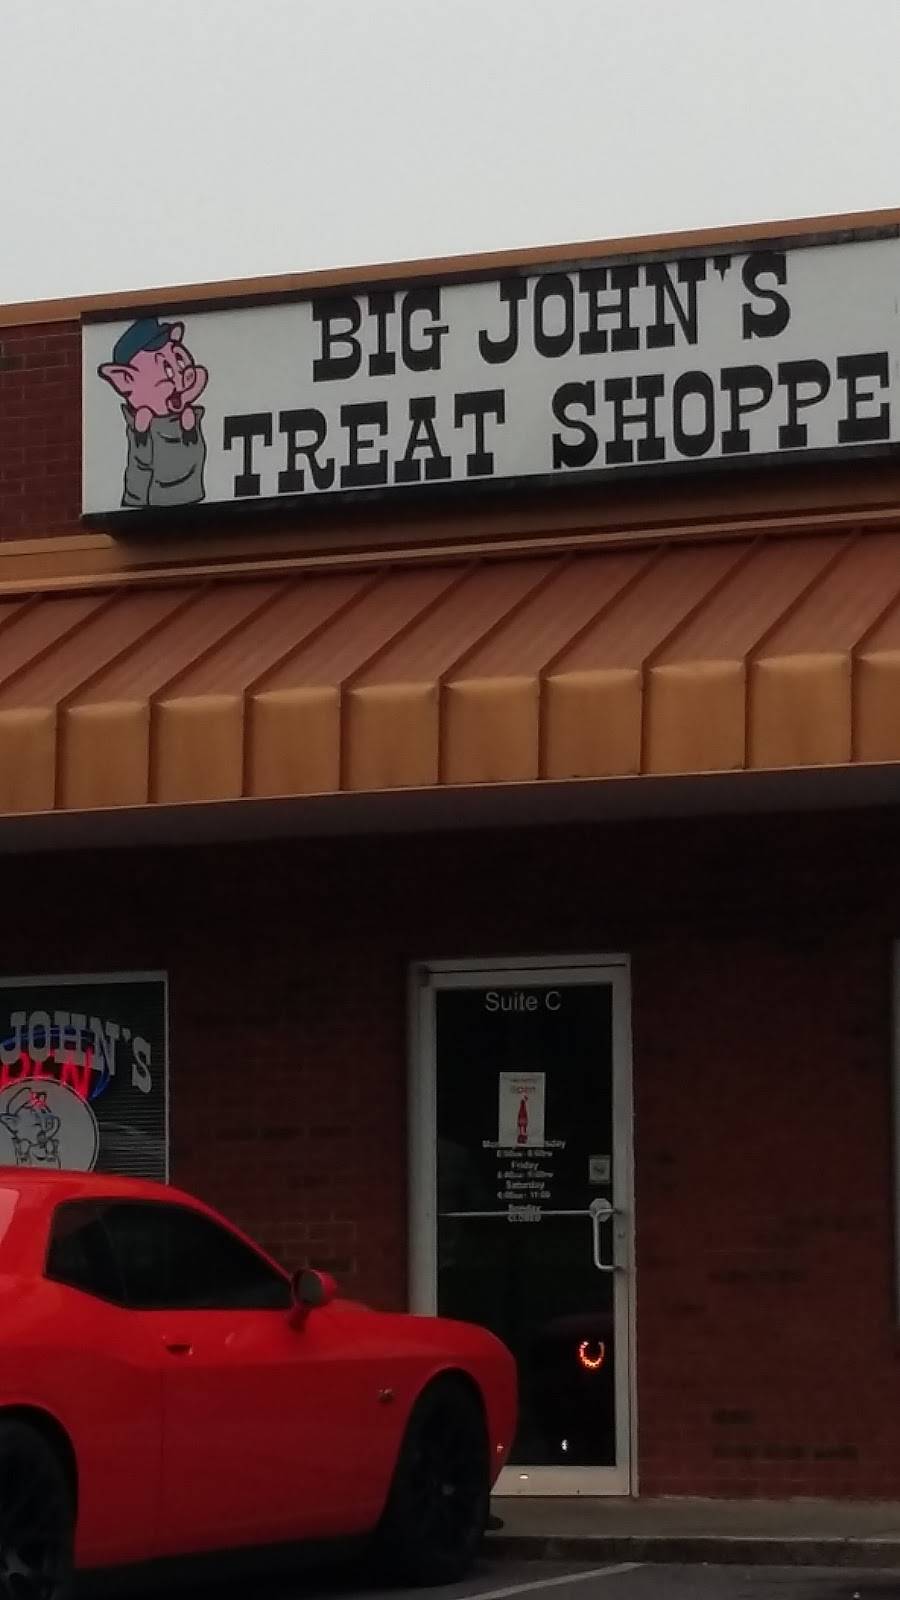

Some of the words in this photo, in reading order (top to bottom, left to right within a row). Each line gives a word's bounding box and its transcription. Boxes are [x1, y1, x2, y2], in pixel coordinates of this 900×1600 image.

[311, 288, 449, 383] BIG
[478, 250, 791, 365] JOHN'S
[222, 389, 506, 498] TREAT
[551, 351, 891, 470] SHOPPE
[0, 1010, 153, 1094] JOHN'S
[486, 992, 538, 1012] Suite
[546, 991, 562, 1011] C
